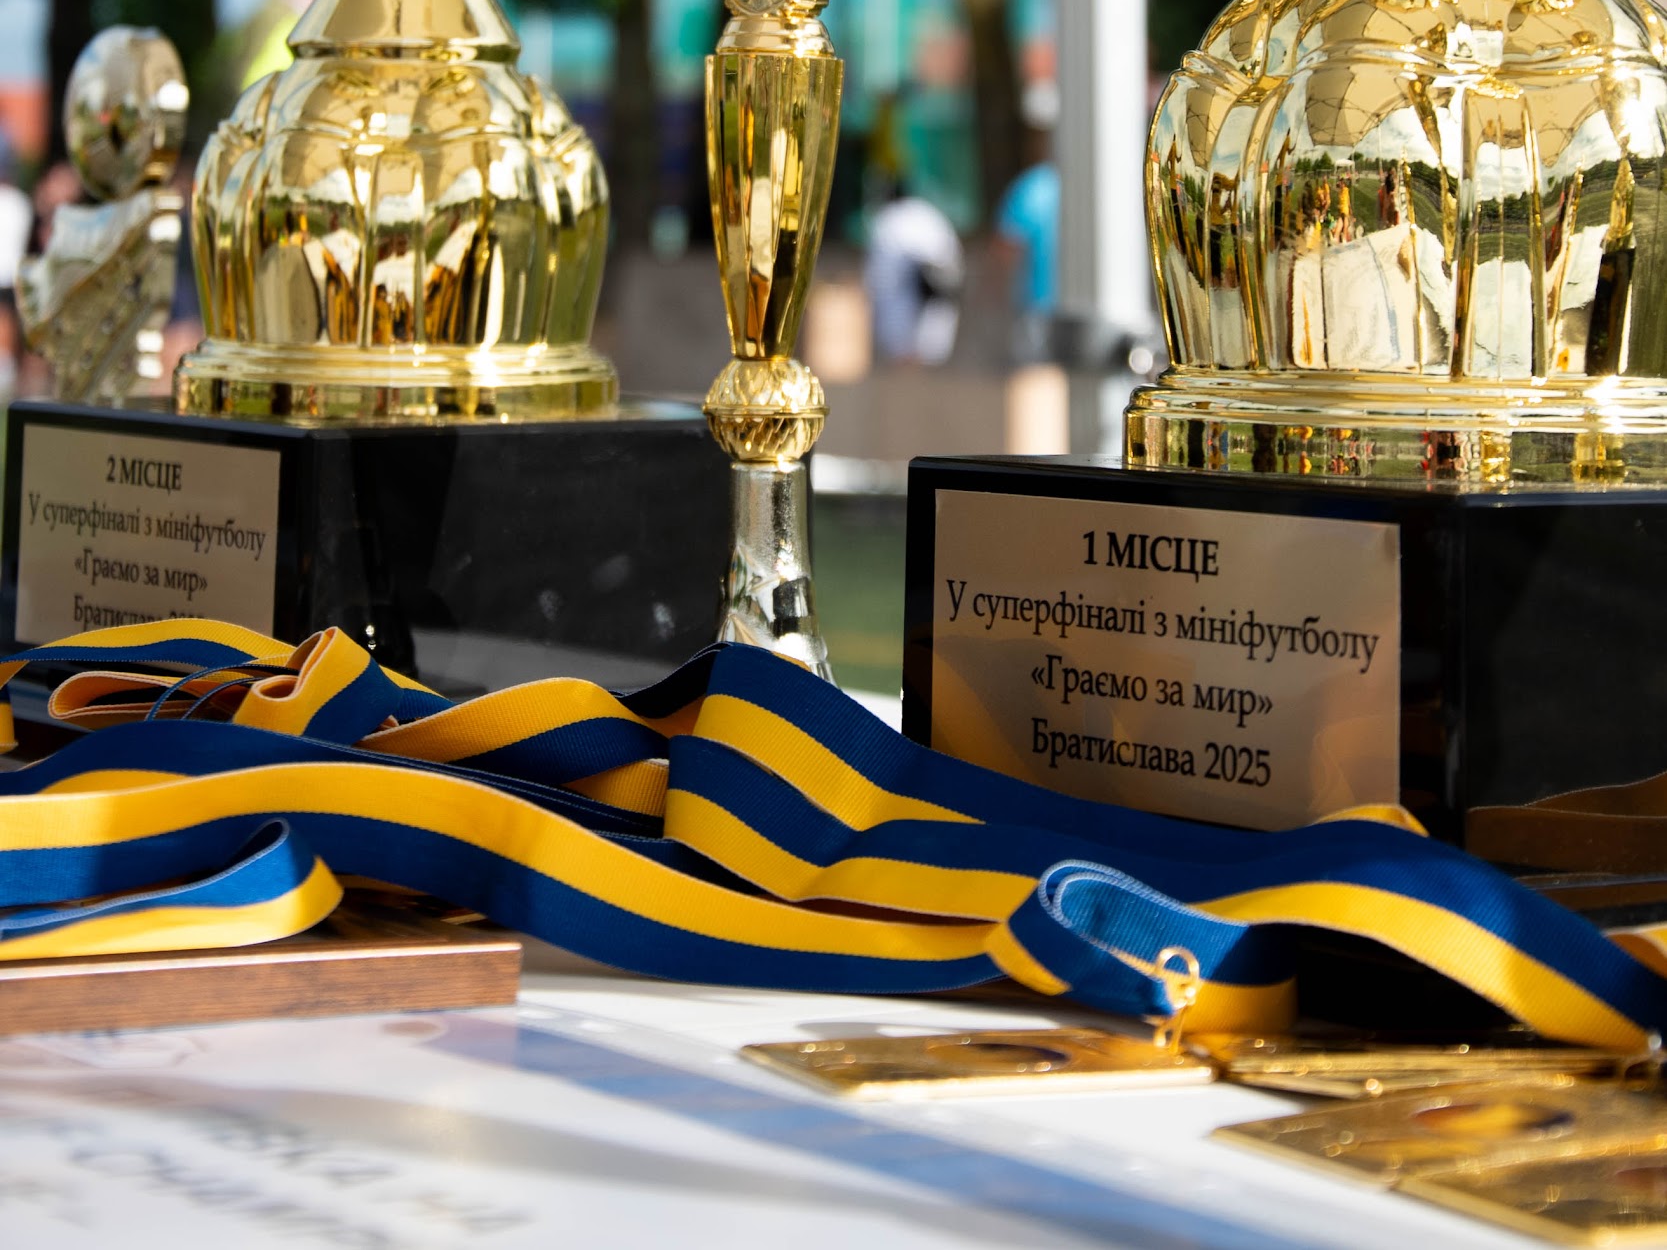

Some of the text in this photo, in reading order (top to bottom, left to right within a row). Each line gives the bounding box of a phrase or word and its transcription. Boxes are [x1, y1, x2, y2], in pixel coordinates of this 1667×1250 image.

[106, 455, 182, 494] 2 МІСЦЕ
[29, 493, 266, 561] У суперфіналі з мініфутболу
[1083, 531, 1220, 582] 1 МІСЦЕ
[74, 548, 208, 601] «Граємо за мир»
[74, 595, 162, 631] Братисла
[946, 579, 1379, 673] У суперфіналі з мініфутболу
[1031, 654, 1273, 728] «Граємо за мир»
[1031, 717, 1271, 787] Братислава 2025
